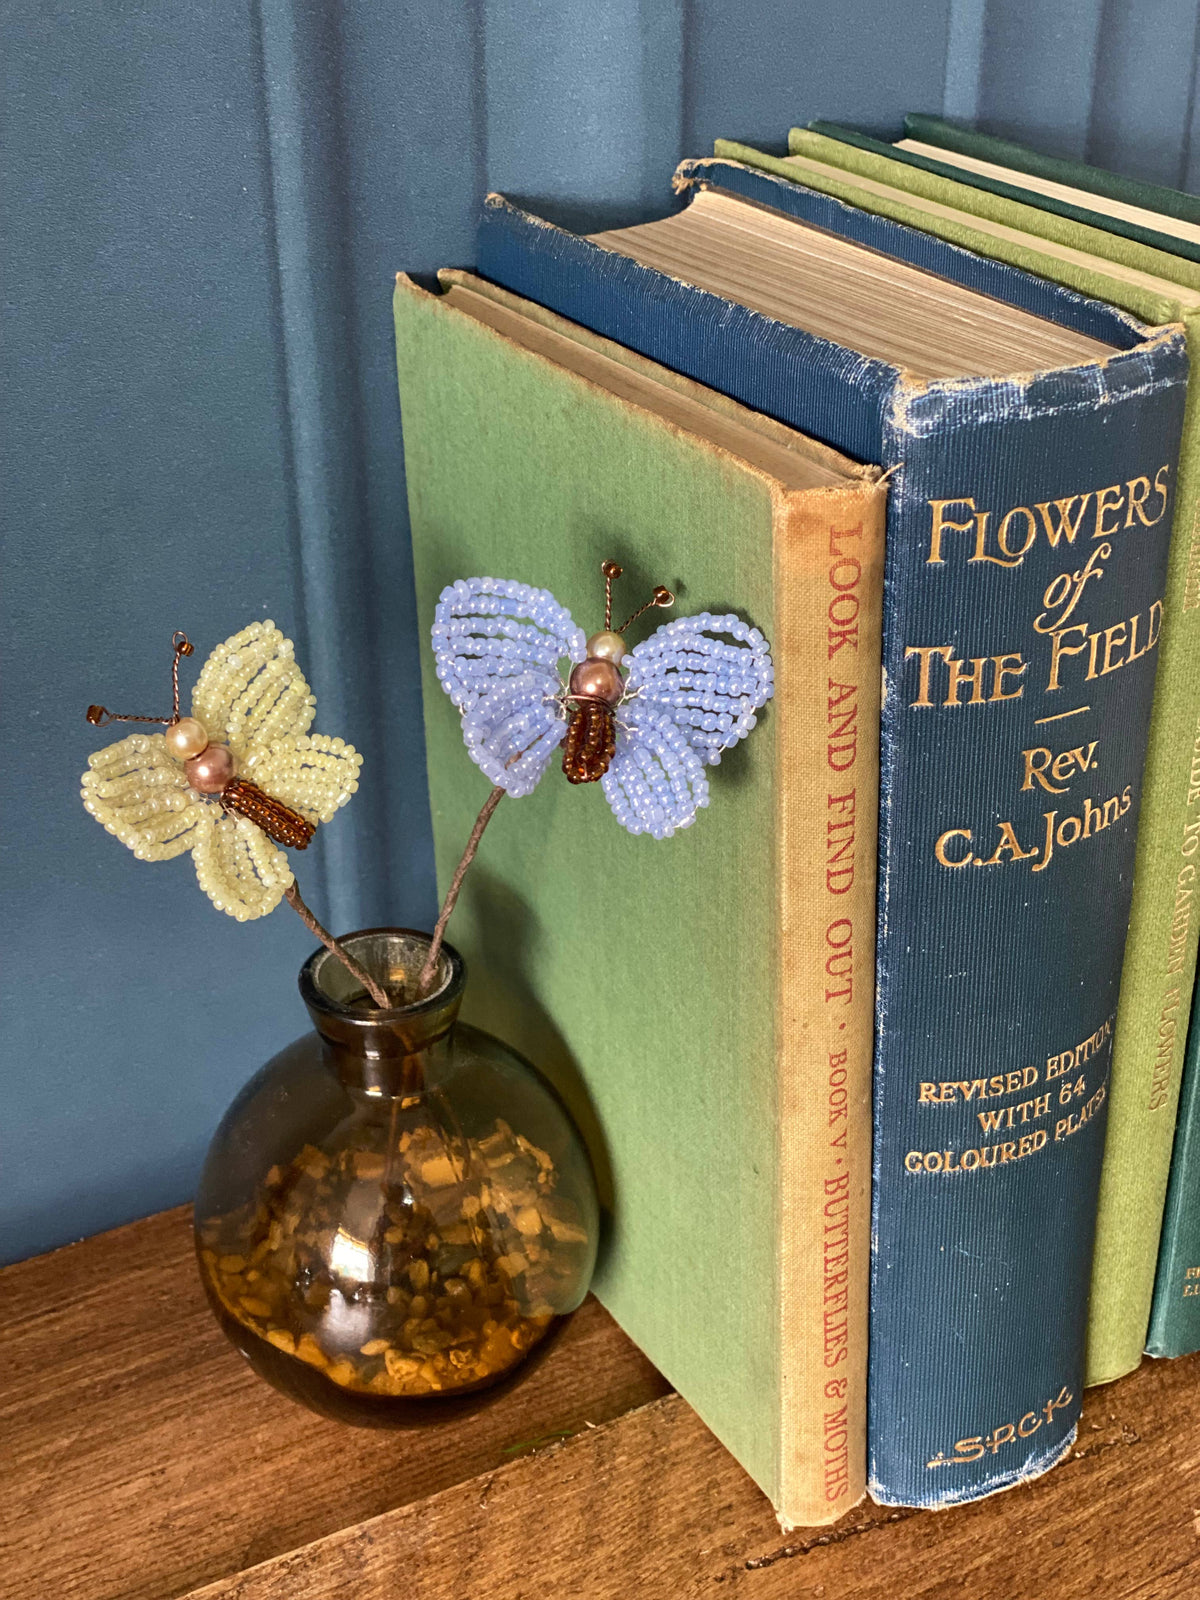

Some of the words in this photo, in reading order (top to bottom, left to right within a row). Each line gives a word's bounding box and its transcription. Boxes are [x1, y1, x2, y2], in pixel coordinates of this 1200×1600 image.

[926, 464, 1169, 567] FLOWERS
[828, 522, 863, 661] LOOK
[1033, 543, 1111, 633] of
[905, 645, 1027, 708] THE
[1045, 600, 1164, 693] FIELD
[827, 677, 857, 772] AND
[1020, 740, 1099, 794] Rev.
[826, 788, 856, 896] FIND
[825, 918, 853, 1005] OUT
[1167, 864, 1196, 976] GARDEN
[828, 1048, 848, 1128] BOOK
[918, 1066, 1039, 1102] REVISED
[1149, 986, 1181, 1112] FLOWERS
[829, 1129, 847, 1152] V
[977, 1093, 1052, 1133] WITH
[1059, 1073, 1085, 1105] 64
[904, 1130, 1047, 1174] COLOURED
[824, 1171, 850, 1369] BUTTERFLIES
[824, 1376, 848, 1400] &
[824, 1404, 848, 1502] MOTHS
